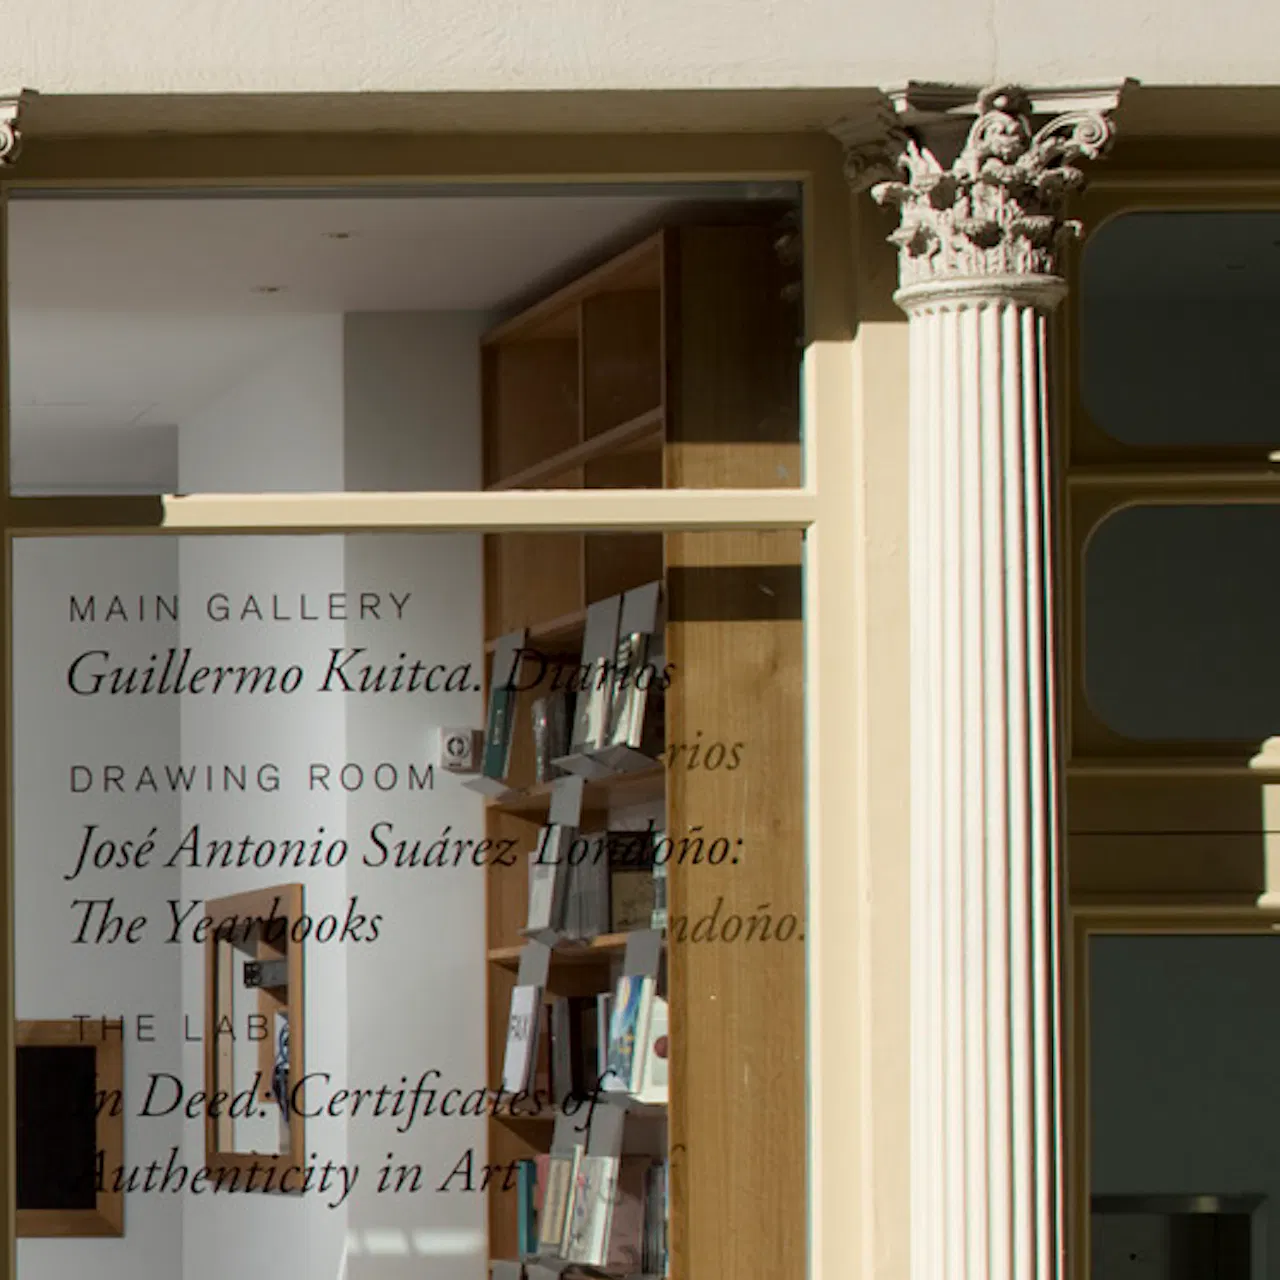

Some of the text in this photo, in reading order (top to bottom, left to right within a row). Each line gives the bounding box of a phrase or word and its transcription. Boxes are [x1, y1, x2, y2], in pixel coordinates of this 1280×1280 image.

[69, 592, 412, 621] MAIN GALLERY
[67, 646, 677, 696] Guillermo Kuitca. Diarios
[70, 763, 436, 793] DRAWING ROOM
[63, 817, 744, 880] José Antonio Suárez Londoño:
[69, 893, 383, 945] The Yearbooks
[72, 1013, 269, 1042] THE LAB
[137, 1070, 269, 1120] Deed:
[290, 1069, 547, 1134] Certificates
[561, 1069, 618, 1133] of
[73, 1146, 521, 1210] Authenticity in Art
